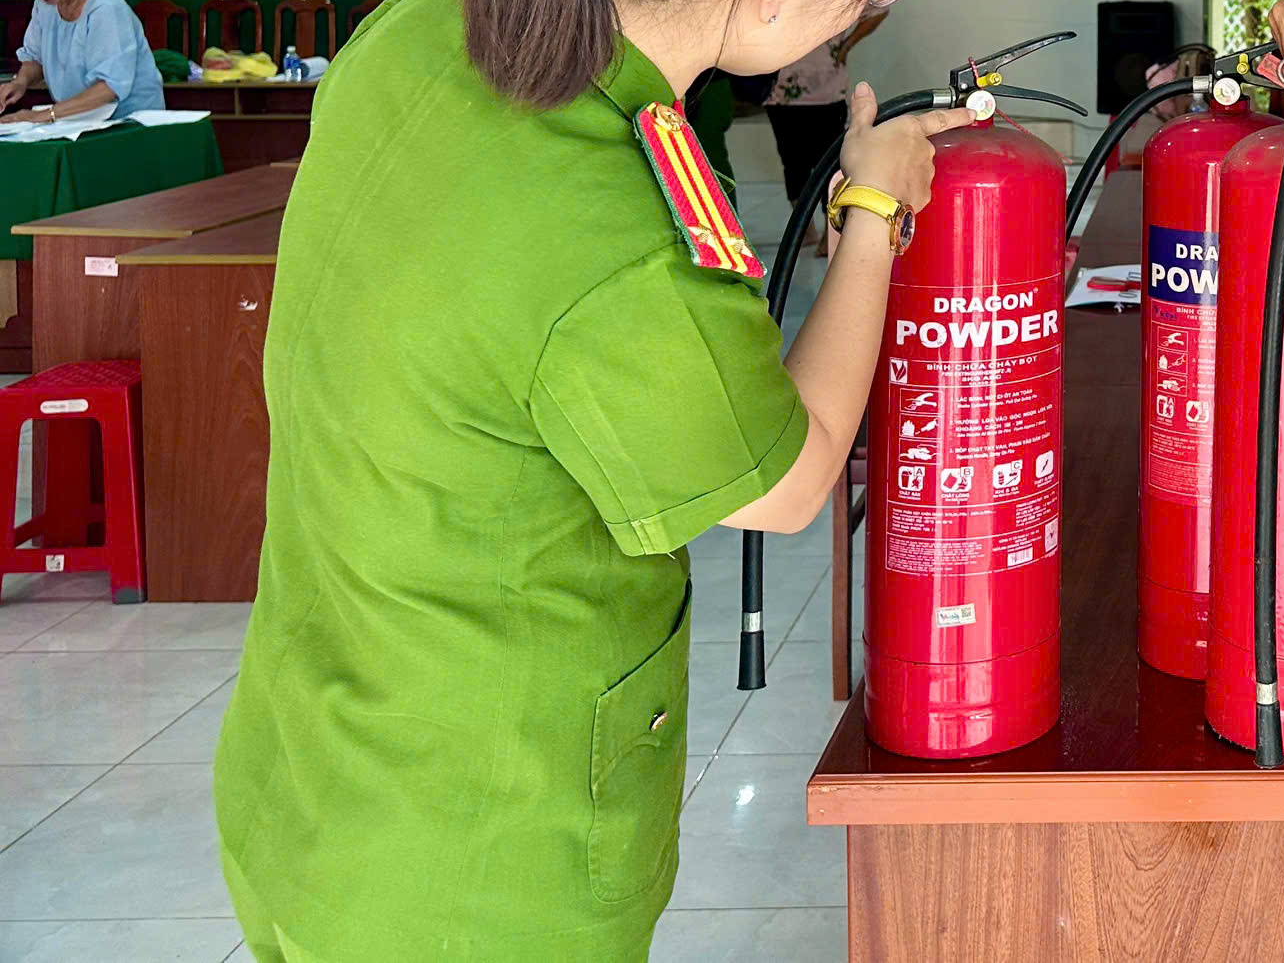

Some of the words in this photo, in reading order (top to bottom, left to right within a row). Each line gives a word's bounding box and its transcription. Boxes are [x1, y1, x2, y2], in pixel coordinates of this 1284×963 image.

[933, 291, 1034, 314] DRAGON
[896, 309, 1059, 349] POWDER
[926, 363, 951, 371] BÌNH
[1019, 355, 1038, 365] BỘT
[916, 467, 923, 475] A
